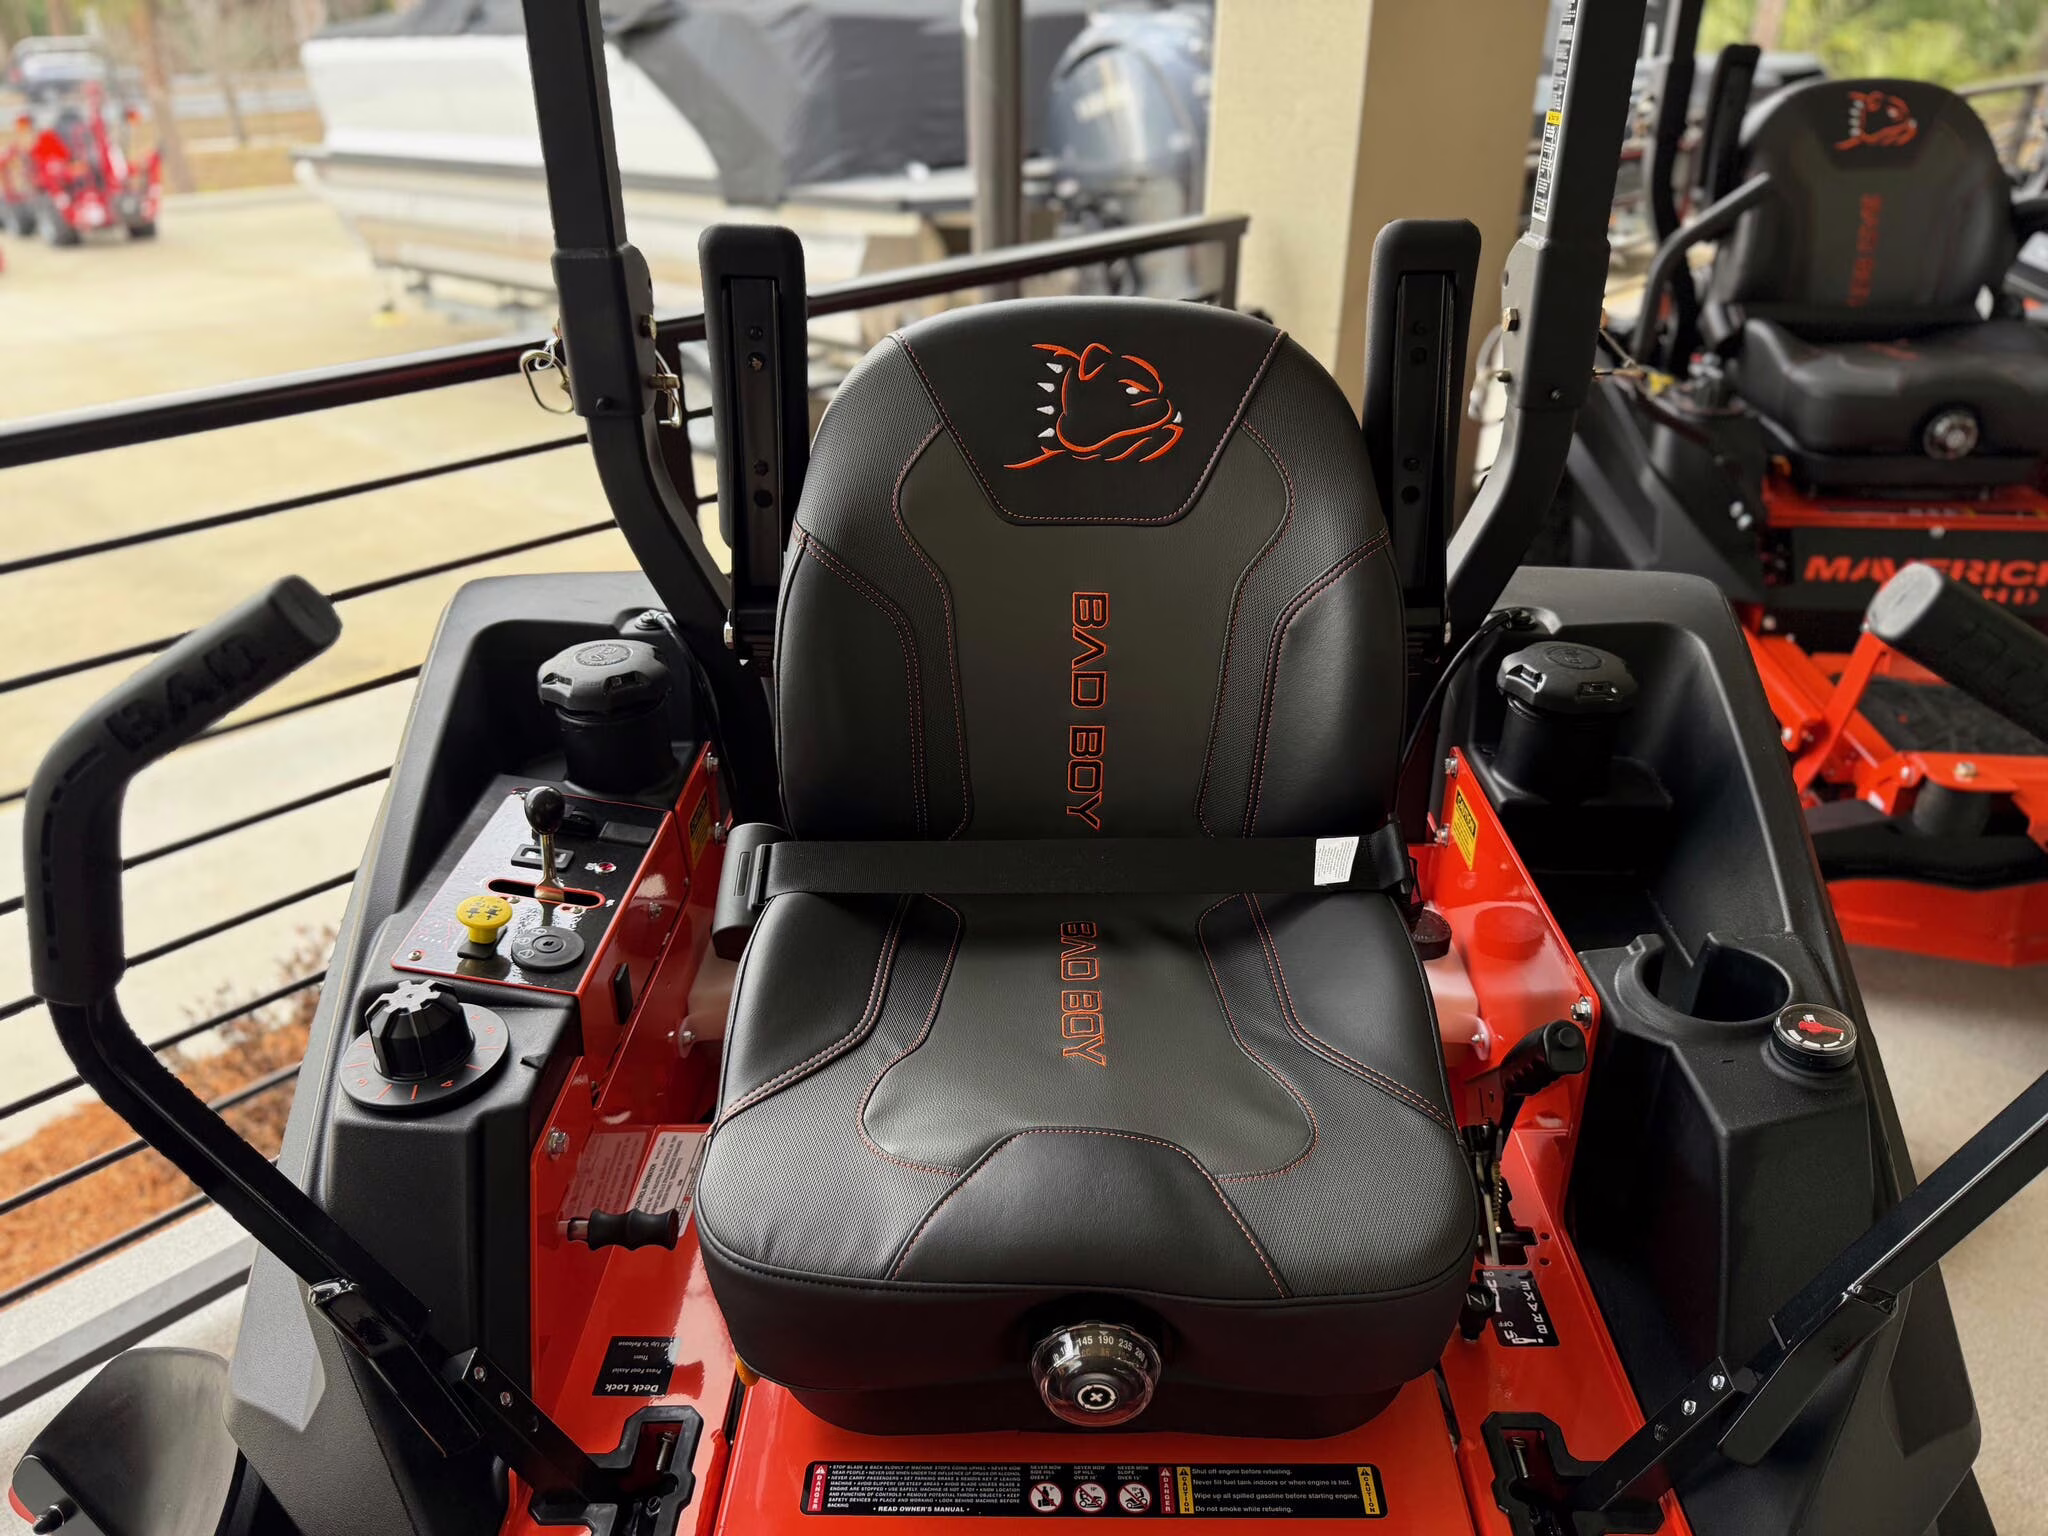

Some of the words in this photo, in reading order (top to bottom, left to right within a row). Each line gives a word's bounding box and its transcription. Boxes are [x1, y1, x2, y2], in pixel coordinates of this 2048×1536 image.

[1071, 591, 1110, 709] BAD
[1066, 724, 1106, 833] BOY
[1060, 920, 1100, 982] BAD
[1061, 990, 1108, 1067] BOY
[1498, 1320, 1514, 1328] OFF
[1520, 1280, 1548, 1335] BRAKE
[1076, 1335, 1093, 1346] 145
[1098, 1335, 1114, 1345] 190
[1118, 1337, 1133, 1351] 235
[604, 1384, 629, 1392] Lock
[633, 1384, 659, 1393] Deck
[812, 1475, 823, 1509] DANGER
[1163, 1477, 1171, 1511] DANGER
[1363, 1477, 1375, 1512] CAUTION
